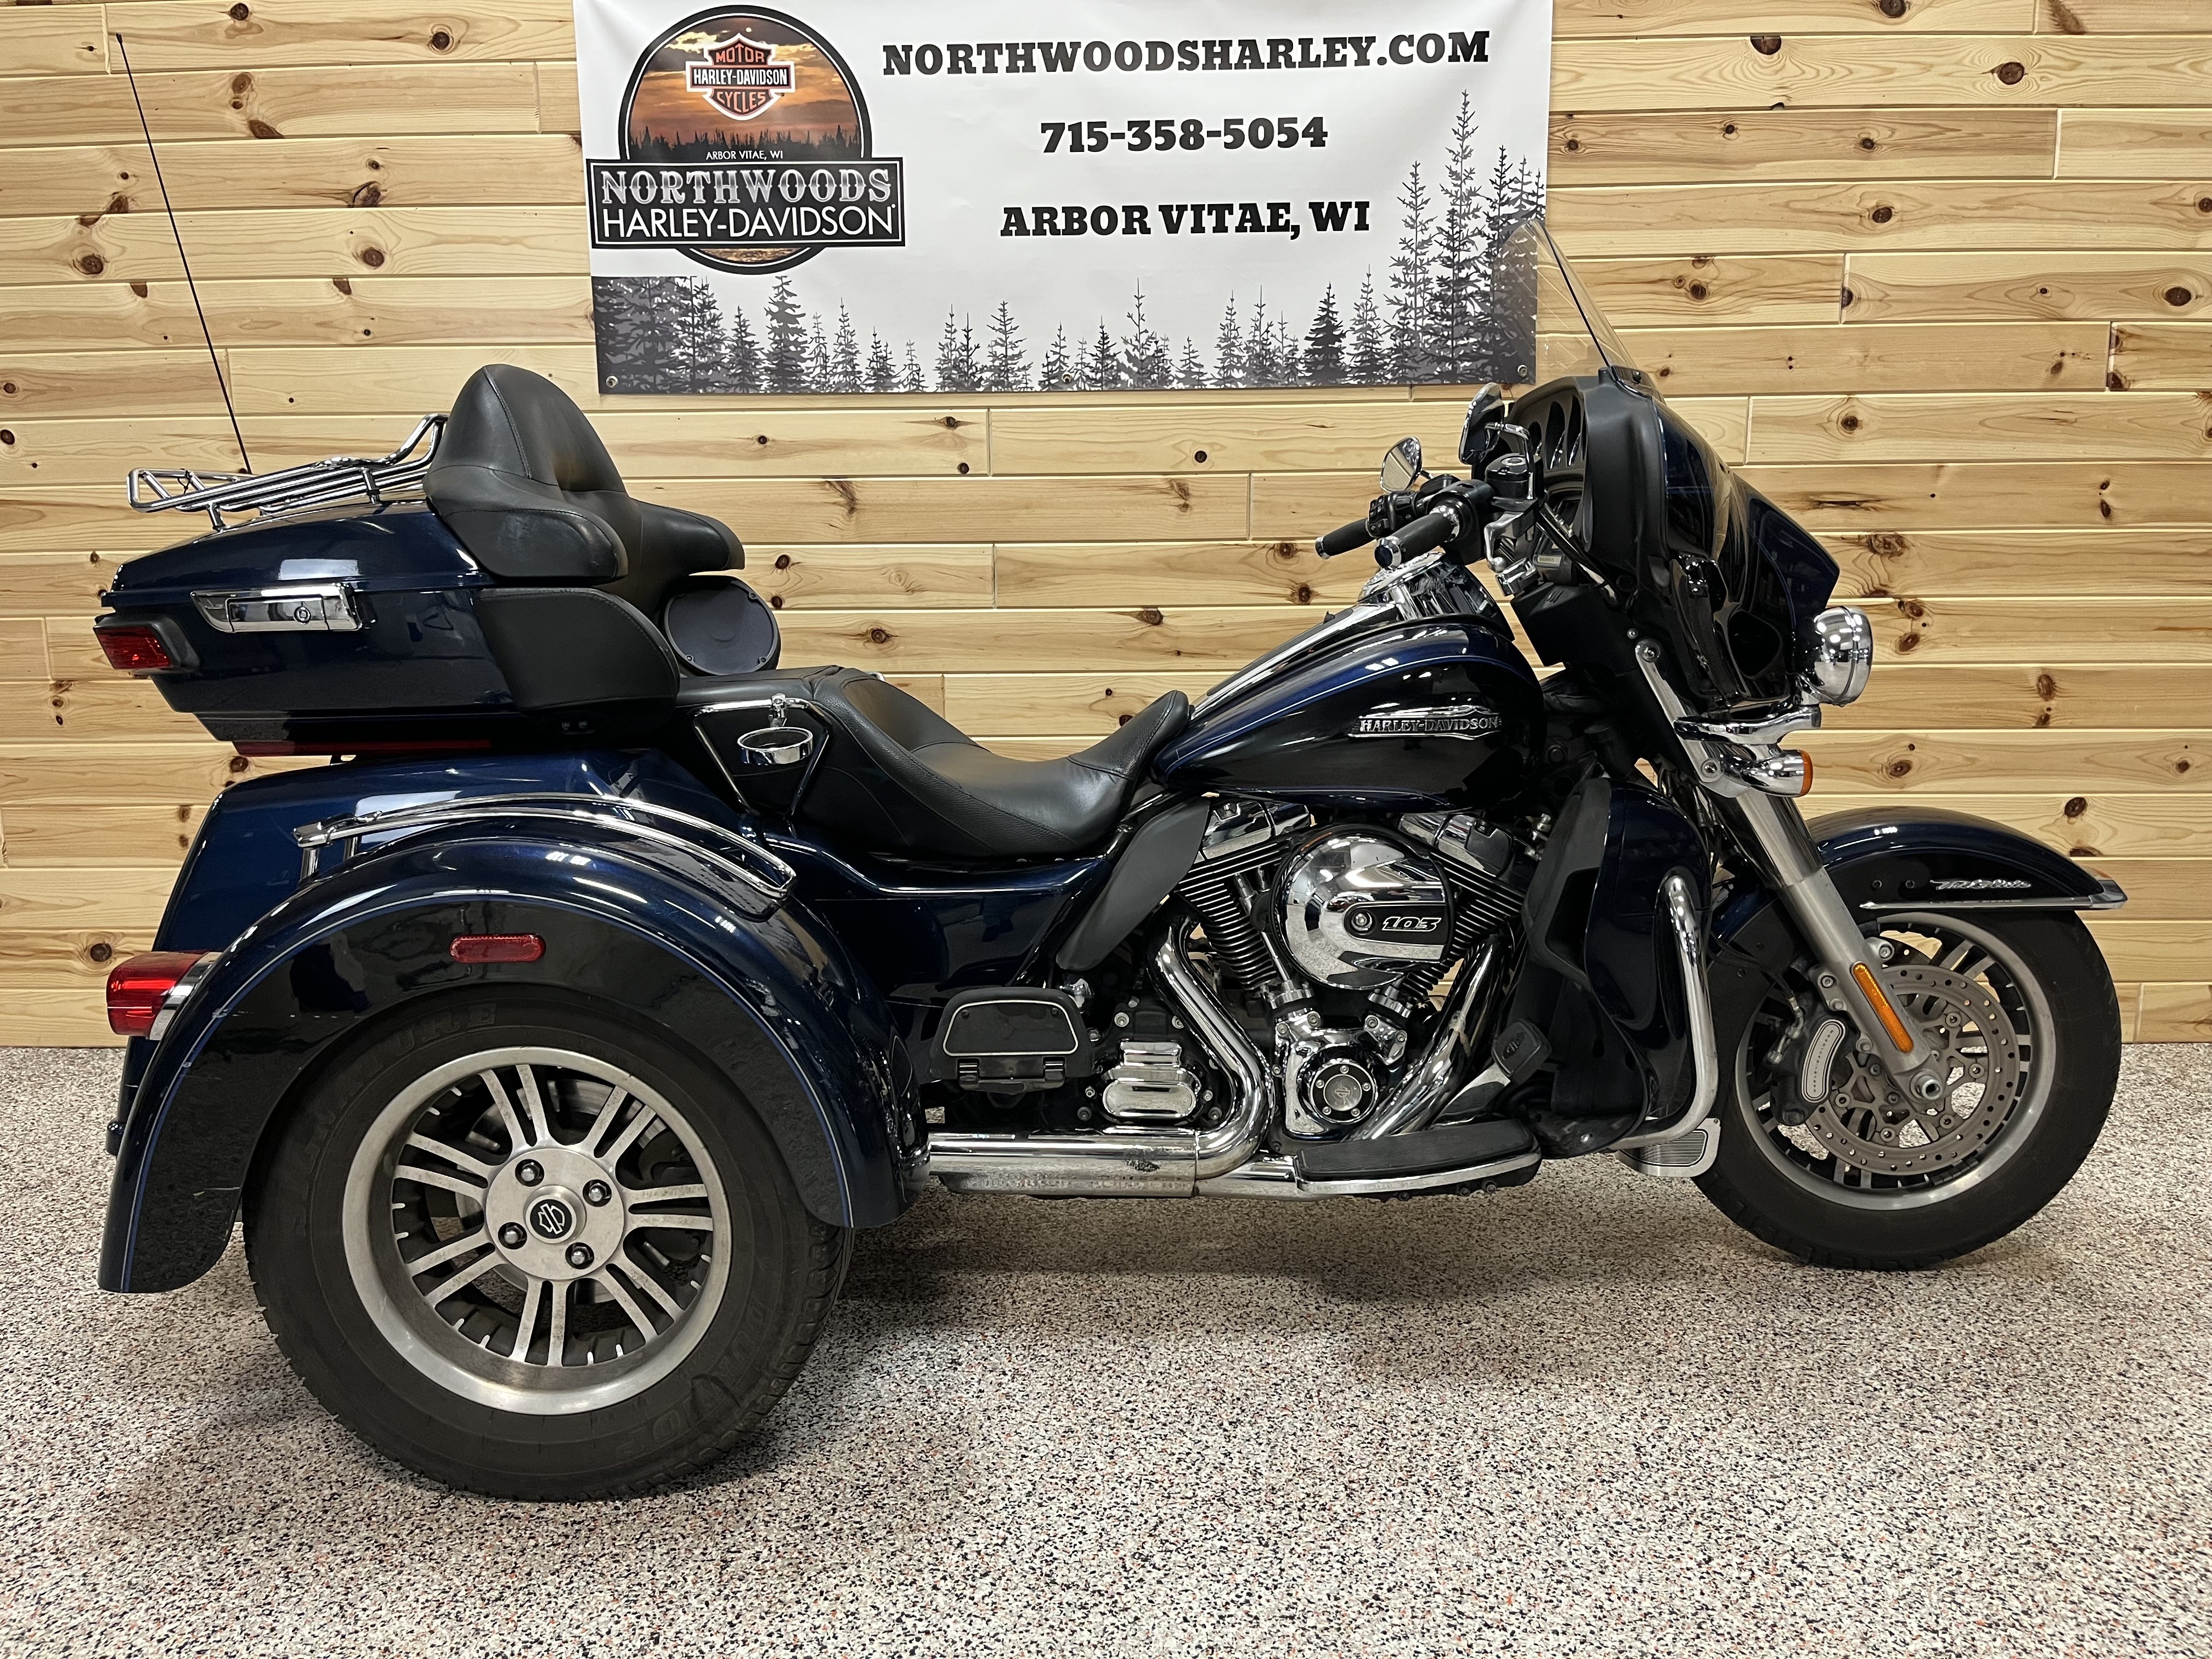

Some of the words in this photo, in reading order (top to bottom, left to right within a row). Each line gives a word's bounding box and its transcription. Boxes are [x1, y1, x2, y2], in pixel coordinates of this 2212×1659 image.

[716, 44, 764, 63] MOTOR
[883, 30, 1490, 76] NORTHWOODSHARLEY.COM
[693, 68, 787, 86] HARLEY-DAVIDSON
[716, 92, 766, 112] CYCLES
[1041, 116, 1328, 153] 715-358-5054
[706, 150, 737, 160] ARBOR
[738, 150, 767, 161] VITAE,
[769, 150, 783, 159] WI
[601, 168, 892, 204] NORTHWOODS
[603, 205, 894, 238] HARLEY-DAVIDSON
[1000, 205, 1152, 236] ARBOR
[1158, 202, 1300, 240] VITAE,
[1308, 201, 1370, 232] WI
[1359, 716, 1499, 733] HARLEY-DAVIDSON
[1381, 916, 1442, 932] 103
